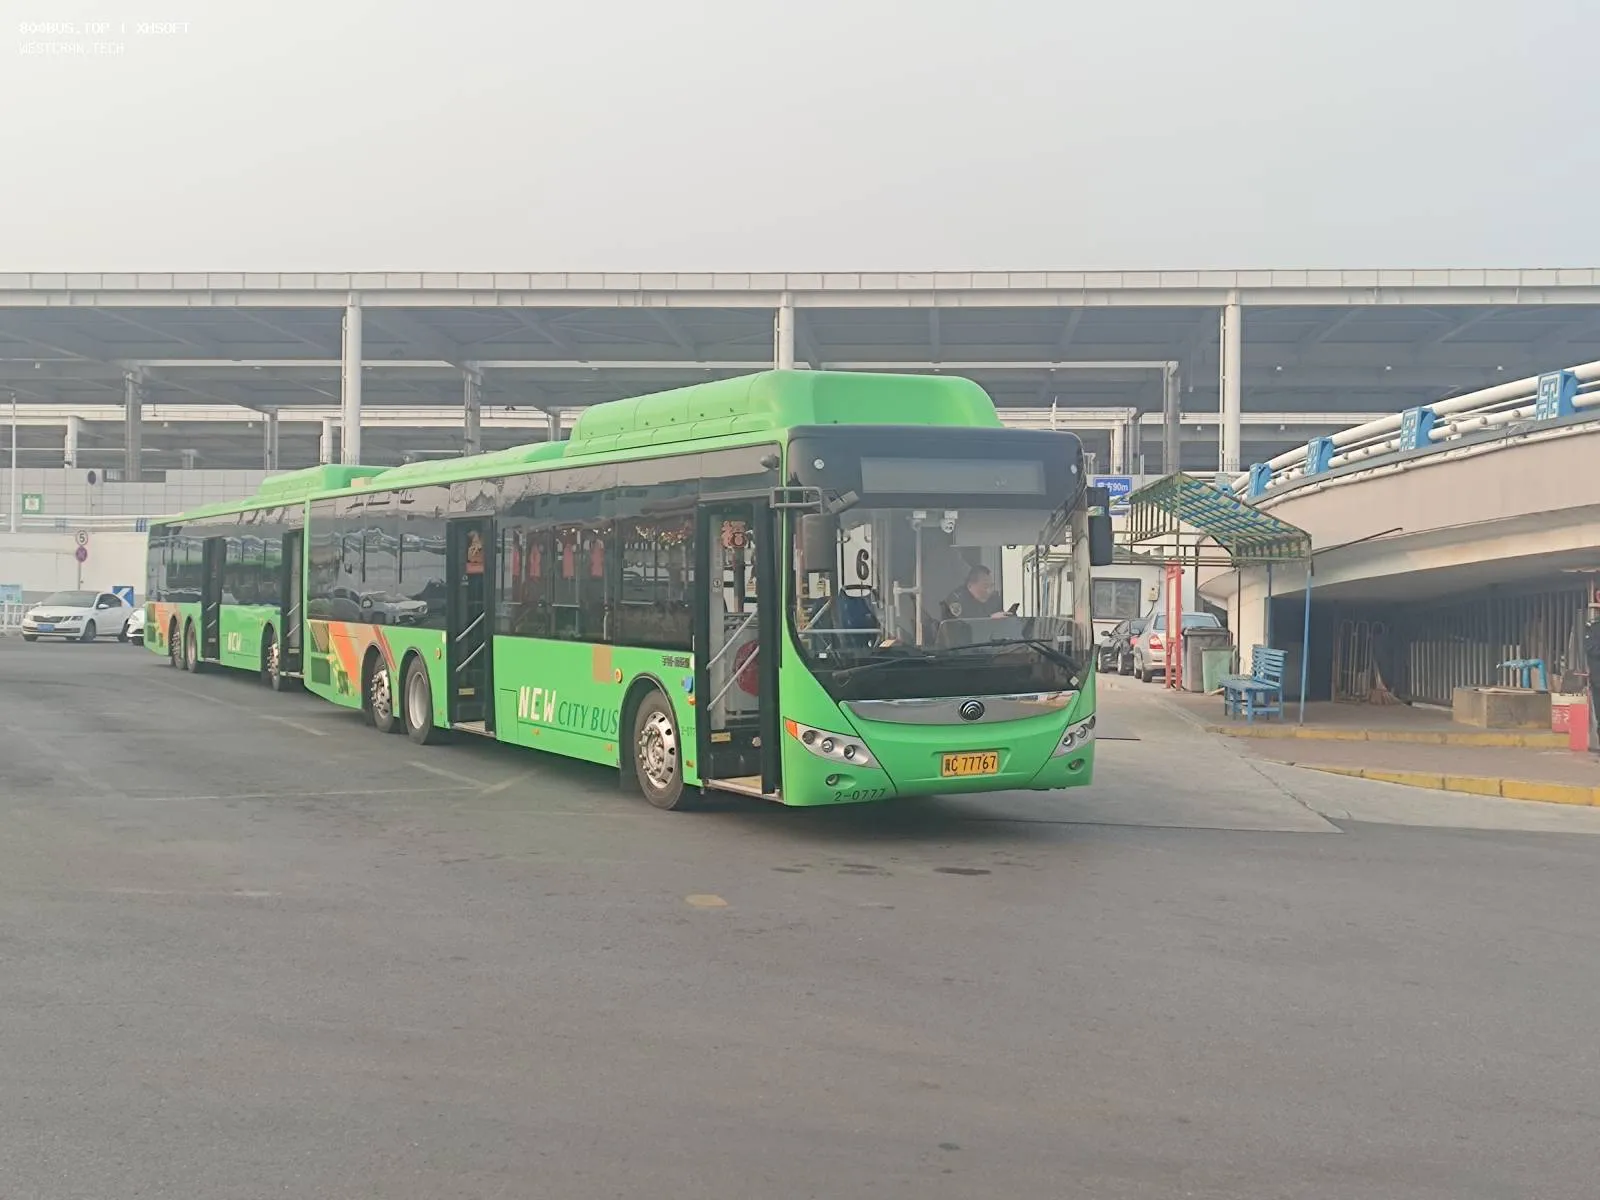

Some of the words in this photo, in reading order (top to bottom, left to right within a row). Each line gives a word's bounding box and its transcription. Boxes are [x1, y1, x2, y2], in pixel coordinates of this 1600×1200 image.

[856, 549, 870, 581] 6
[518, 685, 557, 723] NEW
[558, 701, 589, 729] CITY
[590, 706, 619, 735] BUS
[834, 788, 886, 802] 2-0777
